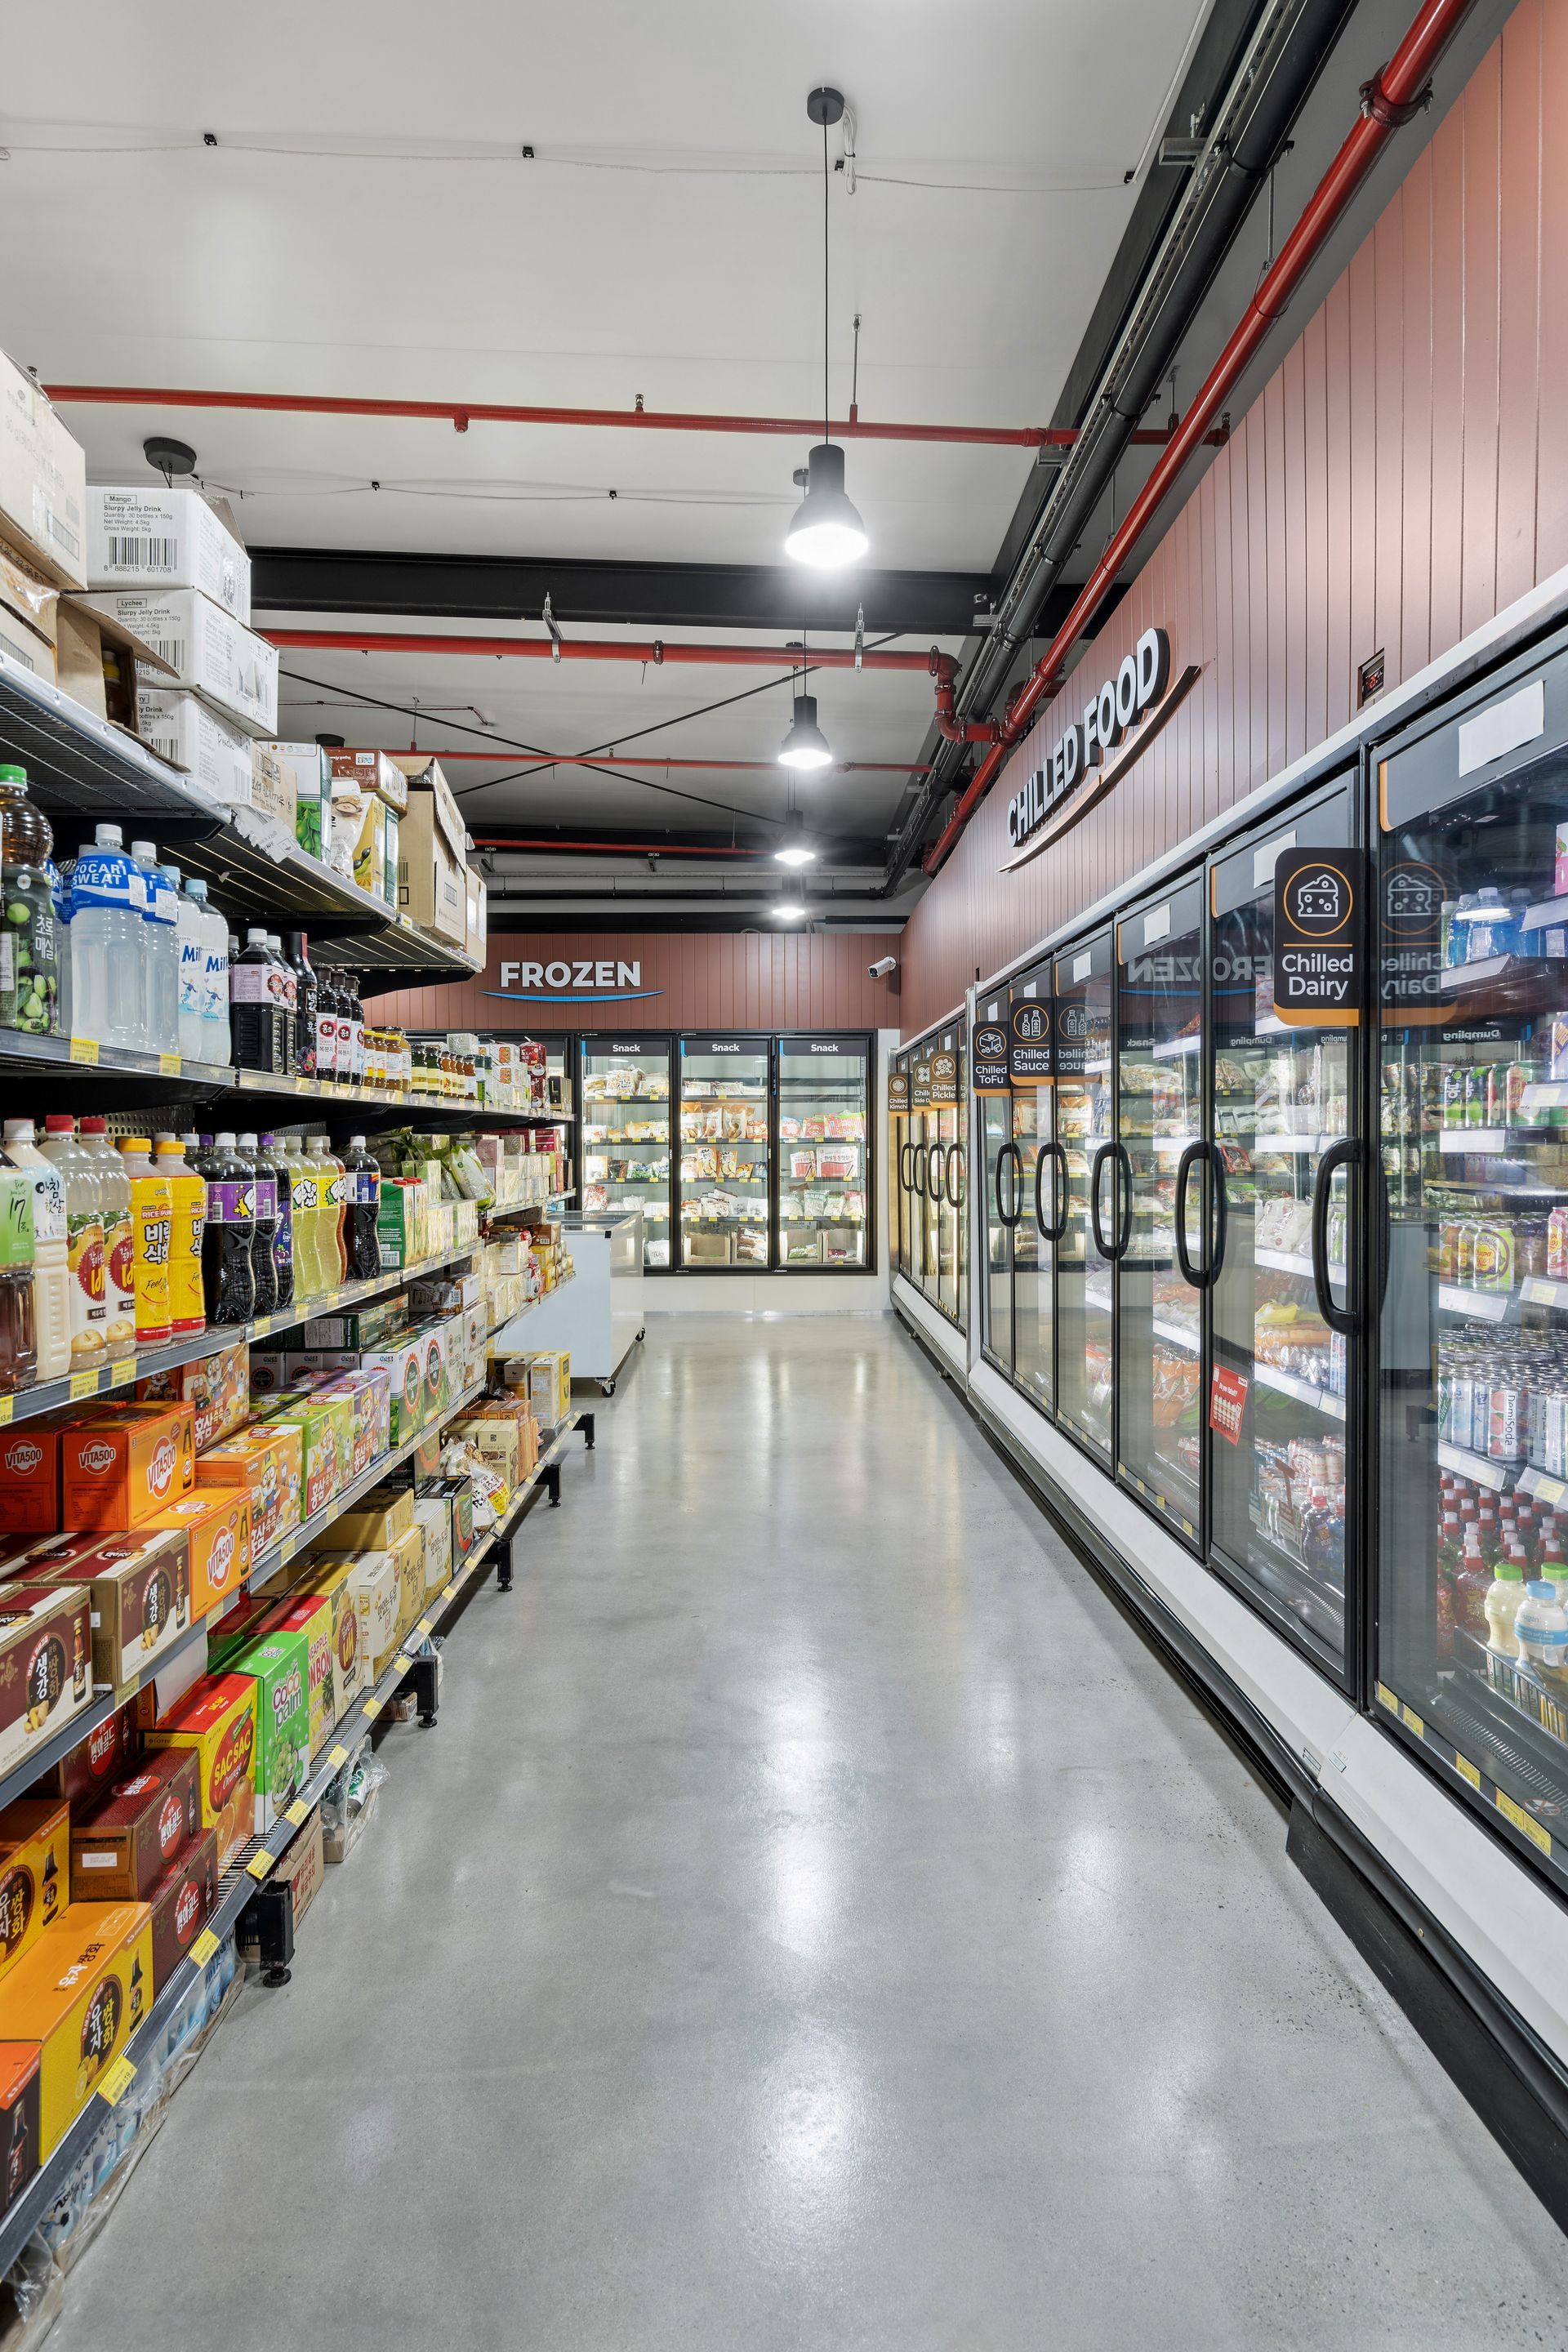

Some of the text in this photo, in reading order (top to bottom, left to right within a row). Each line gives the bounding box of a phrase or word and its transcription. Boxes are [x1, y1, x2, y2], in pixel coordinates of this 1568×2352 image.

[1006, 627, 1168, 848] CHILLED FOOD
[72, 873, 122, 886] SWEAT
[75, 862, 127, 875] POCARI
[500, 961, 641, 988] FROZEN
[1281, 954, 1353, 973] Chilled
[1288, 975, 1348, 1000] Dairy
[322, 1023, 332, 1034] 홍초
[612, 1044, 641, 1053] Snack
[711, 1043, 740, 1053] Snack
[810, 1043, 840, 1053] Snack
[1013, 1049, 1050, 1059] Chilled
[975, 1065, 1008, 1075] Chilled
[979, 1075, 1004, 1085] ToFu
[1013, 1060, 1049, 1071] Sauce
[35, 1177, 60, 1200] 아침
[9, 1197, 26, 1234] 17
[45, 1198, 65, 1214] 햇살
[141, 1209, 159, 1218] RICE
[195, 1412, 213, 1448] 홍삼
[1505, 1395, 1516, 1446] DemiSoda
[6, 1448, 42, 1468] VITA500
[79, 1448, 115, 1468] VITA500
[147, 1445, 176, 1493] VITA500
[312, 1478, 325, 1510] 홍삼
[251, 1522, 265, 1554] 홍삼
[207, 1536, 234, 1586] VITA500
[149, 1583, 158, 1624] 생강
[35, 1651, 49, 1699] 생강
[47, 1654, 60, 1700] 쌍화
[274, 1687, 302, 1739] palm
[91, 1724, 116, 1765] 쌍화골드
[214, 1748, 233, 1787] SAC
[233, 1728, 252, 1764] SAC
[222, 1762, 243, 1790] Orange
[160, 1805, 183, 1848] 쌍화골드
[11, 1887, 25, 1940] 쌍화
[176, 1888, 199, 1935] 쌍화골드
[89, 2003, 103, 2056] 유자
[102, 1997, 115, 2051] 쌍화
